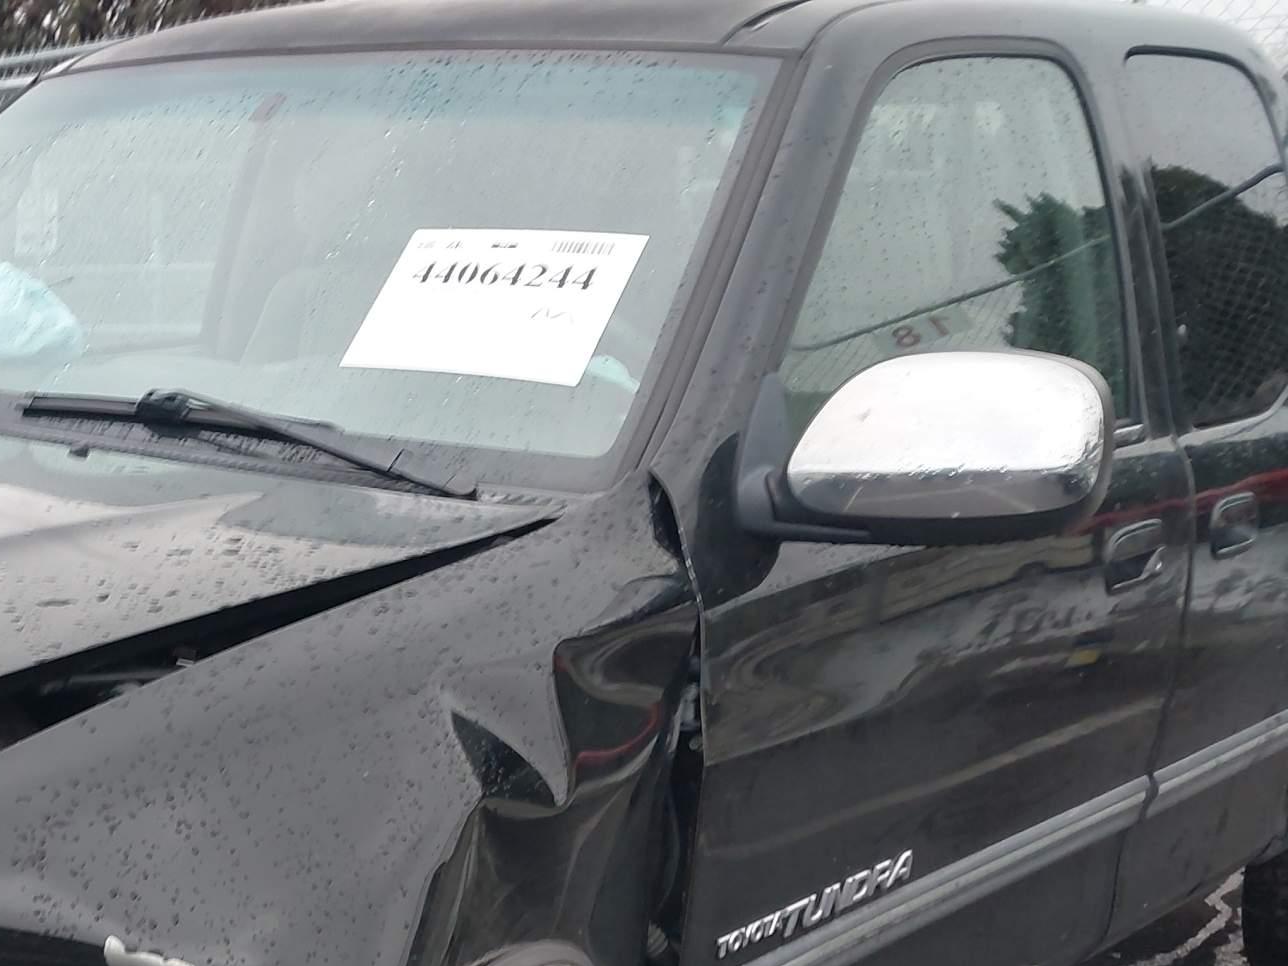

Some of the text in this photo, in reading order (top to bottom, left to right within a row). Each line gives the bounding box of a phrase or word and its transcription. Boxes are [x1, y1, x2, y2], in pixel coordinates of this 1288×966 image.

[412, 260, 599, 291] 44064244
[716, 848, 914, 959] TOYOTA TUNDRA
